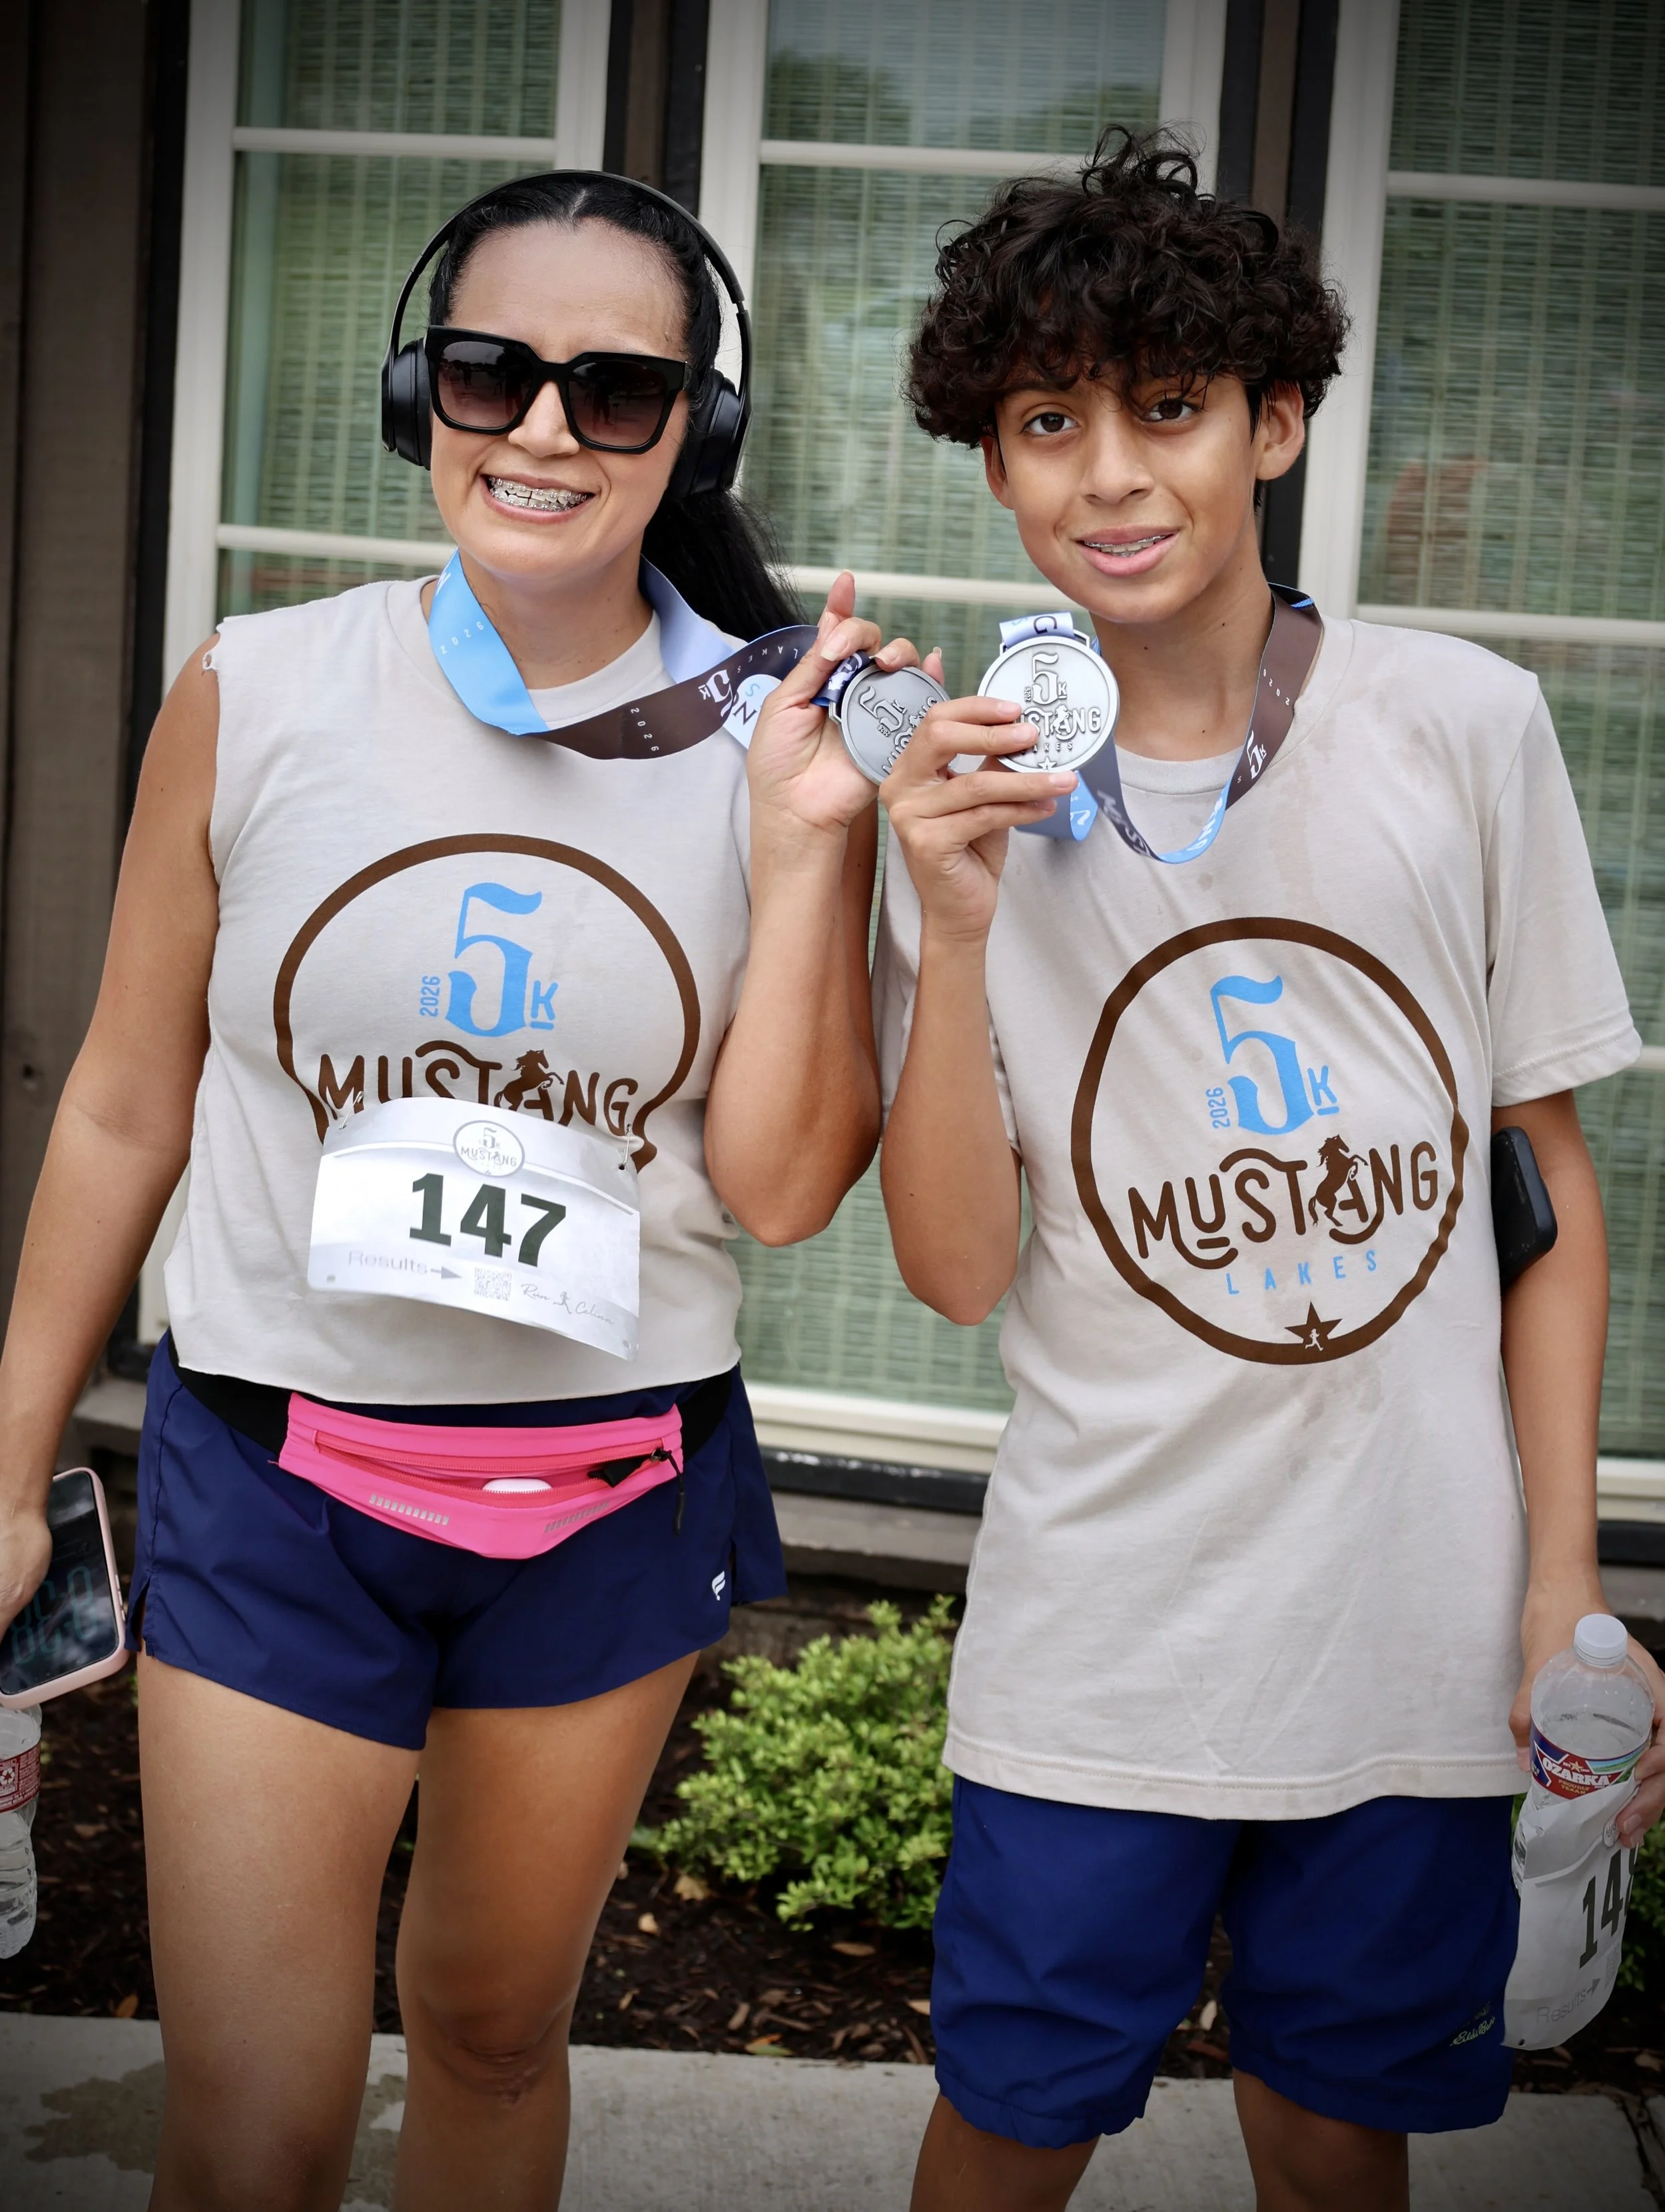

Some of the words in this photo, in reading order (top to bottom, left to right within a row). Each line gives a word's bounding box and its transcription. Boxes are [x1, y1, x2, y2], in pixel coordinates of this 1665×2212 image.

[440, 621, 485, 655] 2026
[737, 645, 799, 674] LAKES
[1032, 653, 1068, 705] 5K
[629, 706, 660, 753] 2026
[859, 685, 908, 733] 5K
[1013, 705, 1102, 741] STANG
[1021, 741, 1074, 755] AKES
[1246, 729, 1268, 780] 5K
[444, 882, 559, 1037] 5K
[419, 975, 440, 1018] 2026
[1209, 974, 1340, 1136] 5K
[1205, 1086, 1231, 1129] 2026
[461, 1146, 517, 1167] MUSTANG
[409, 1172, 567, 1268] 147
[1128, 1134, 1438, 1270] MUSTANG
[348, 1250, 428, 1275] Results
[1226, 1249, 1377, 1295] LAKES
[1542, 1757, 1610, 1786] OZARKA
[1558, 1779, 1591, 1790] PROUDLY
[1536, 1989, 1586, 2024] Results
